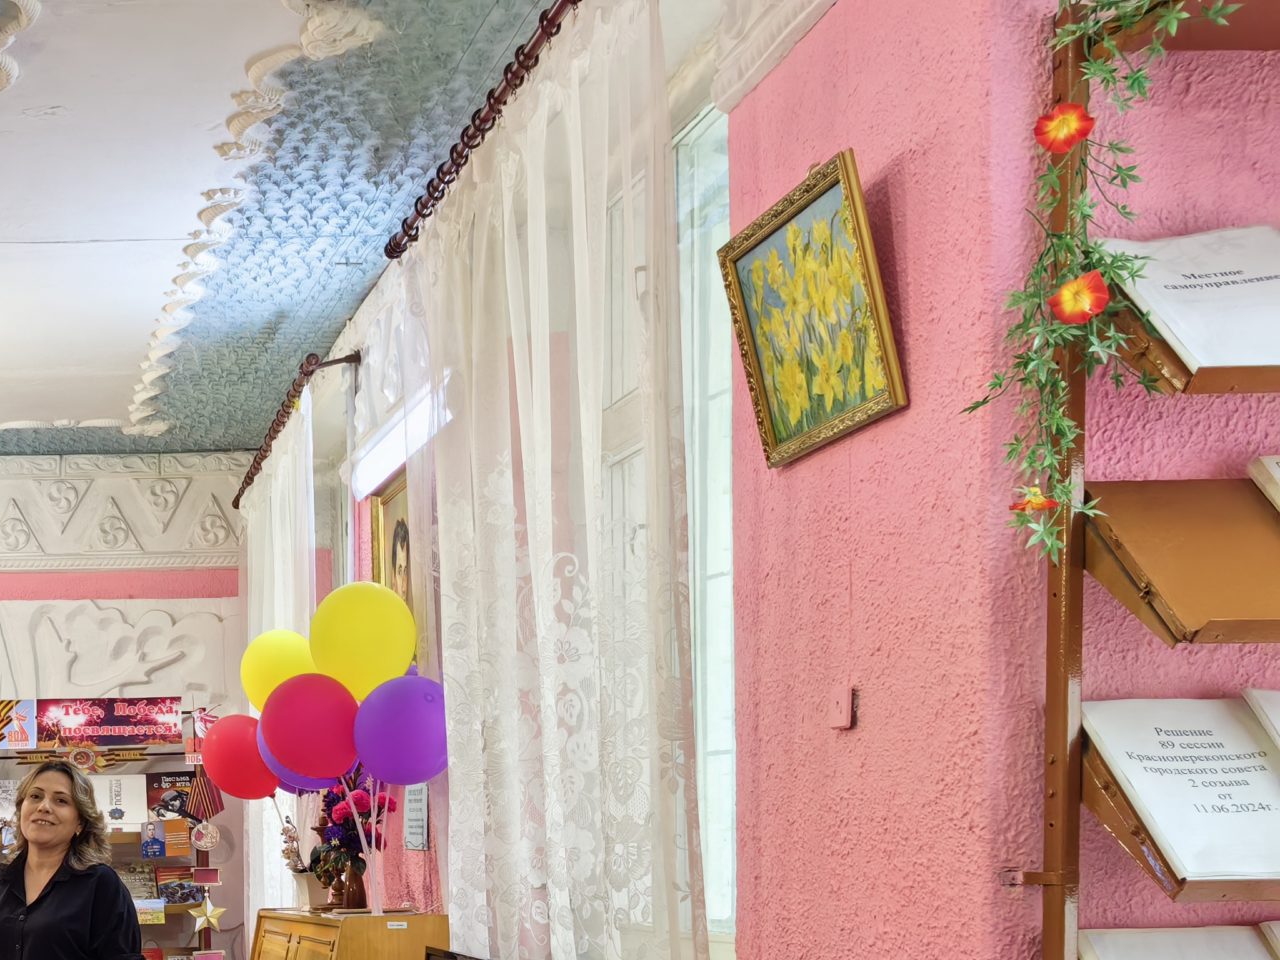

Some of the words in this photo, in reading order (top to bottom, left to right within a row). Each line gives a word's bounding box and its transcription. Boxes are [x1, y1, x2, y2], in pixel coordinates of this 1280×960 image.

[1181, 269, 1245, 280] Местное
[1163, 274, 1280, 290] самоуправление
[62, 701, 104, 718] Тебе,
[114, 701, 179, 716] Победа,
[62, 722, 180, 736] посвящается!
[1154, 726, 1214, 737] Решение
[1158, 740, 1175, 750] 89
[1179, 741, 1225, 750] сессии
[1125, 750, 1268, 764] Красноперекопского
[1143, 766, 1218, 776] городского
[1221, 764, 1268, 775] совета
[161, 781, 191, 789] фрнта
[1188, 778, 1198, 788] 2
[1201, 779, 1250, 788] созыва
[1217, 793, 1233, 801] от
